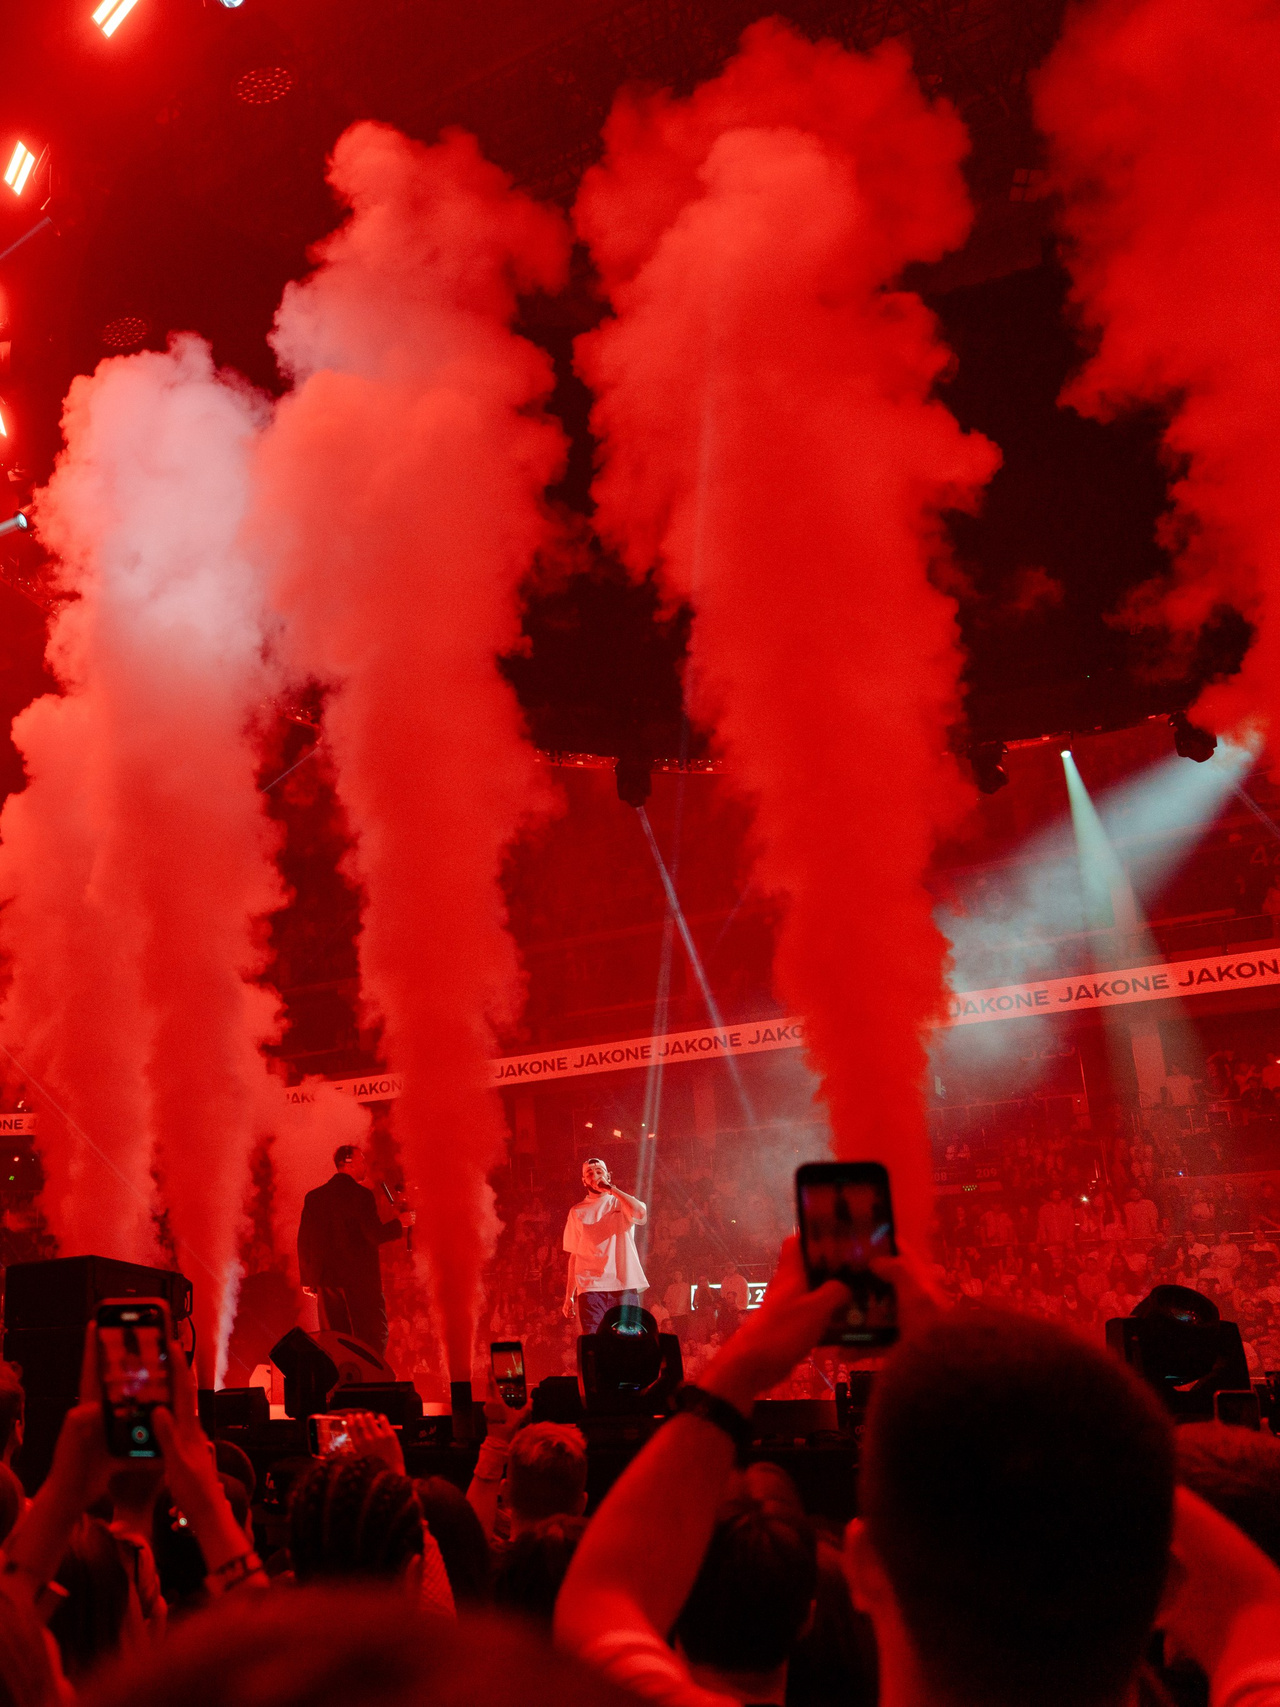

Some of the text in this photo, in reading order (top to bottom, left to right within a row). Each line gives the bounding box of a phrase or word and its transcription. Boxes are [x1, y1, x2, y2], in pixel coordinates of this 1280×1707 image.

[949, 959, 1280, 1018] JAKONE JAKONE JAKON
[495, 1024, 803, 1079] JAKONE JAKONE JAKONE JAKO
[350, 1080, 402, 1096] JAKON
